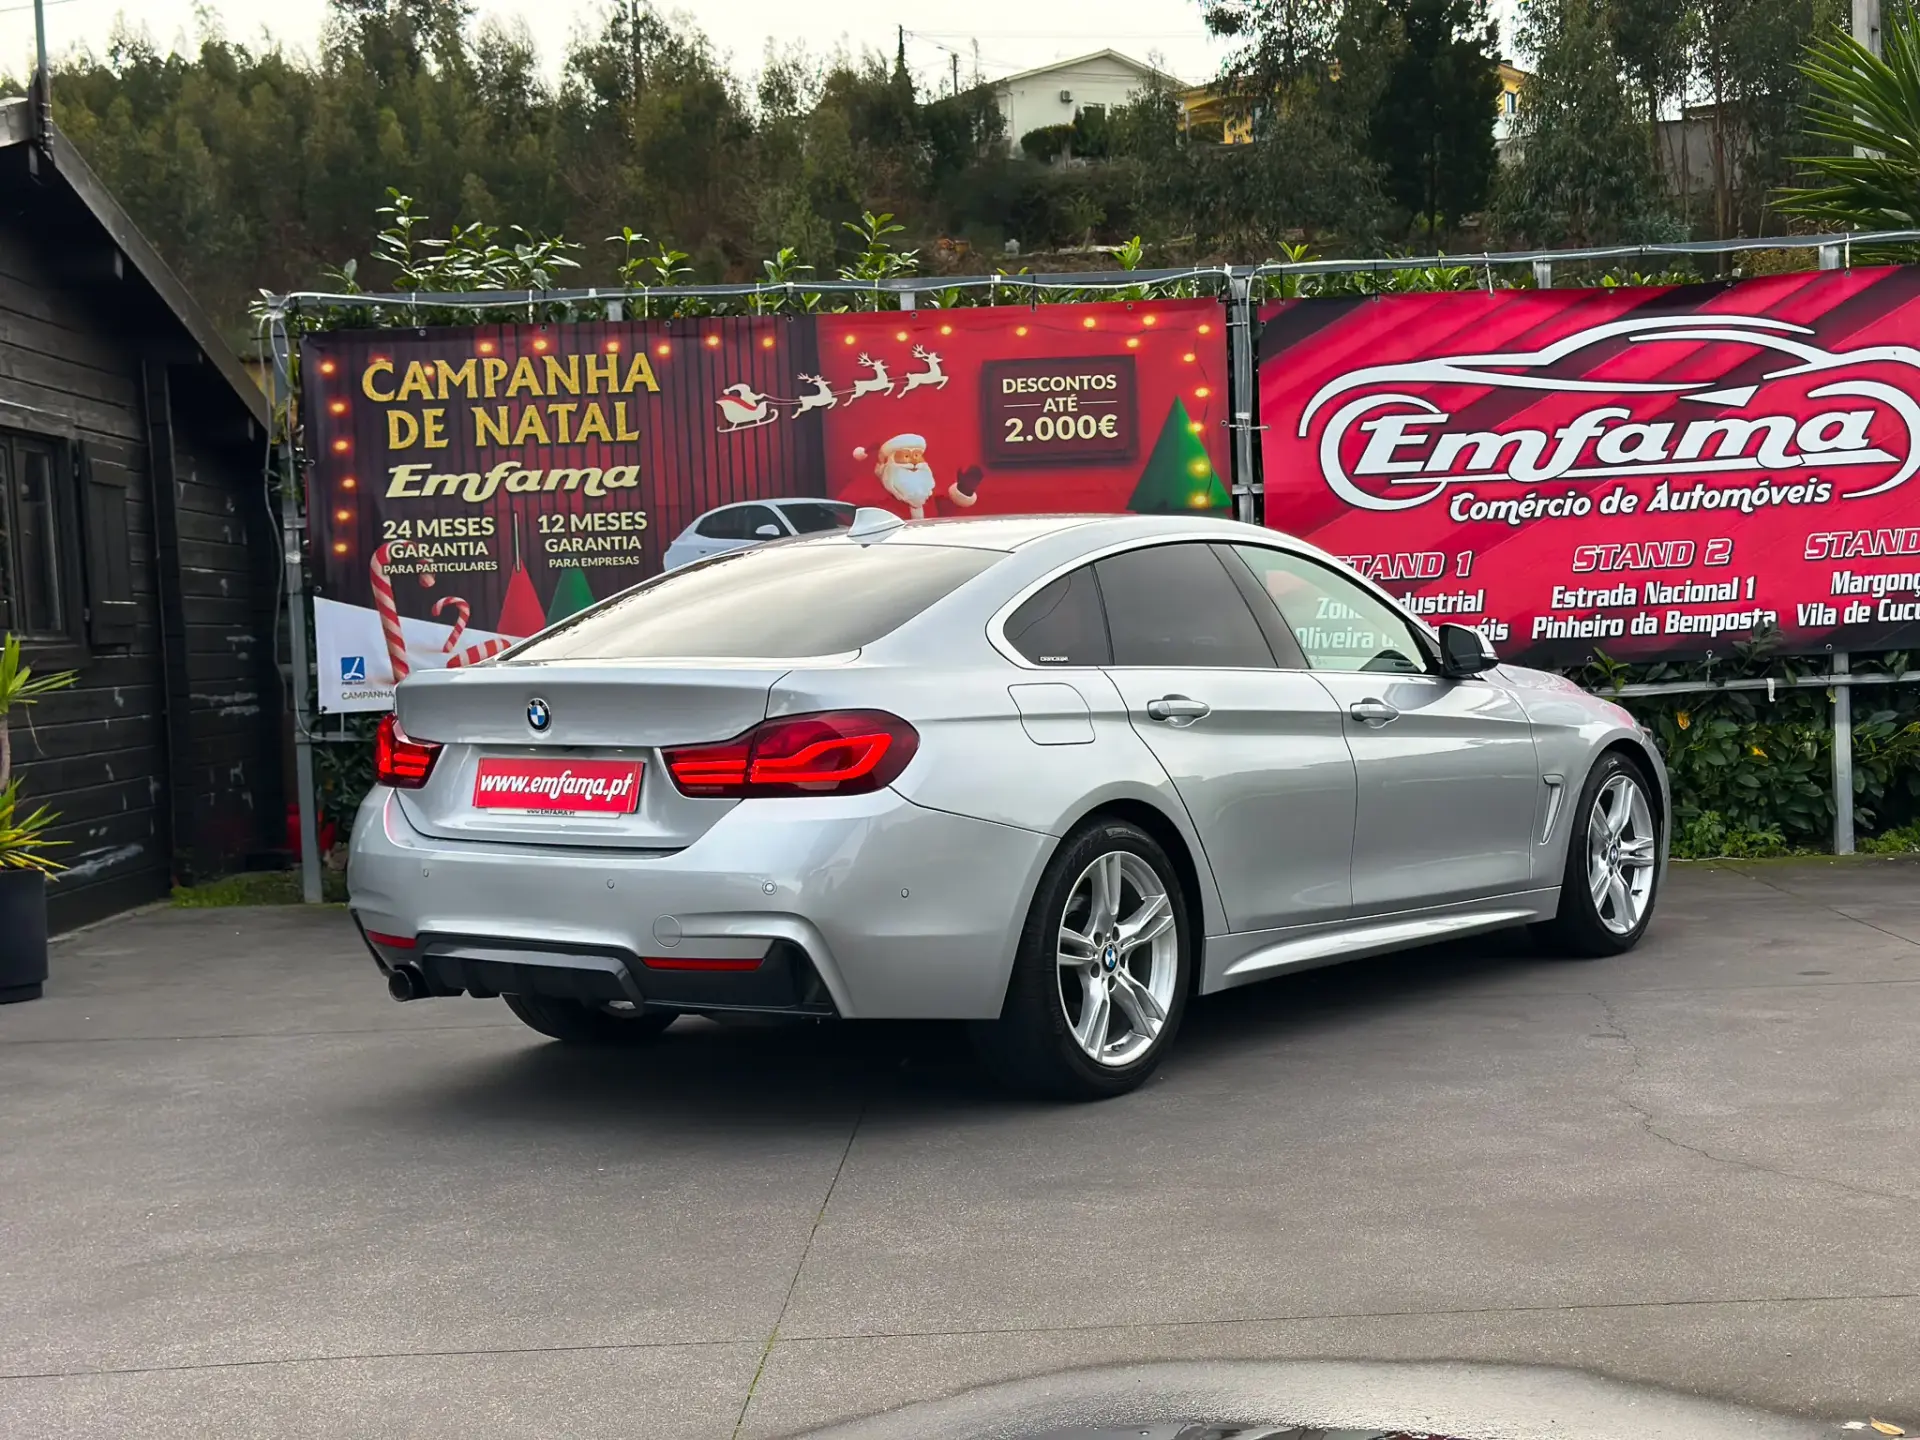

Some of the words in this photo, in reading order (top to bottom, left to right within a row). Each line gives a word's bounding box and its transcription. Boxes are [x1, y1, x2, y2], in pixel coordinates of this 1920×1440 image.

[361, 352, 661, 402] CAMPANHA
[1002, 374, 1117, 394] DESCONTOS
[1043, 394, 1078, 413] ATÉ
[386, 408, 449, 450] DE
[471, 401, 640, 447] NATAL
[1004, 414, 1119, 443] 2.000€
[1353, 407, 1876, 482] Emfama
[385, 461, 641, 502] Emfama
[1449, 491, 1591, 525] Comércio
[1600, 487, 1634, 514] de
[1646, 478, 1832, 513] Automóveis
[382, 520, 412, 539] 24
[417, 517, 495, 538] MESES
[538, 514, 565, 534] 12
[571, 511, 648, 533] MESES
[391, 541, 489, 559] GARANTIA
[545, 535, 642, 553] GARANTIA
[1572, 540, 1695, 572] STAND
[1704, 538, 1733, 566] 2
[383, 563, 414, 574] PARA
[416, 561, 498, 573] PARTICULARES
[549, 558, 578, 568] PARA
[580, 556, 640, 567] EMPRESAS
[1456, 550, 1472, 577] 1
[1551, 582, 1638, 608] Estrada
[1643, 577, 1740, 605] Nacional
[1746, 576, 1755, 599] 1
[1532, 611, 1624, 640] Pinheiro
[1630, 612, 1657, 635] da
[1796, 603, 1837, 626] Vila
[1843, 601, 1871, 624] de
[1295, 626, 1374, 649] Oliveira
[341, 690, 394, 700] CAMPANHA
[480, 769, 633, 802] www.emfama.pt
